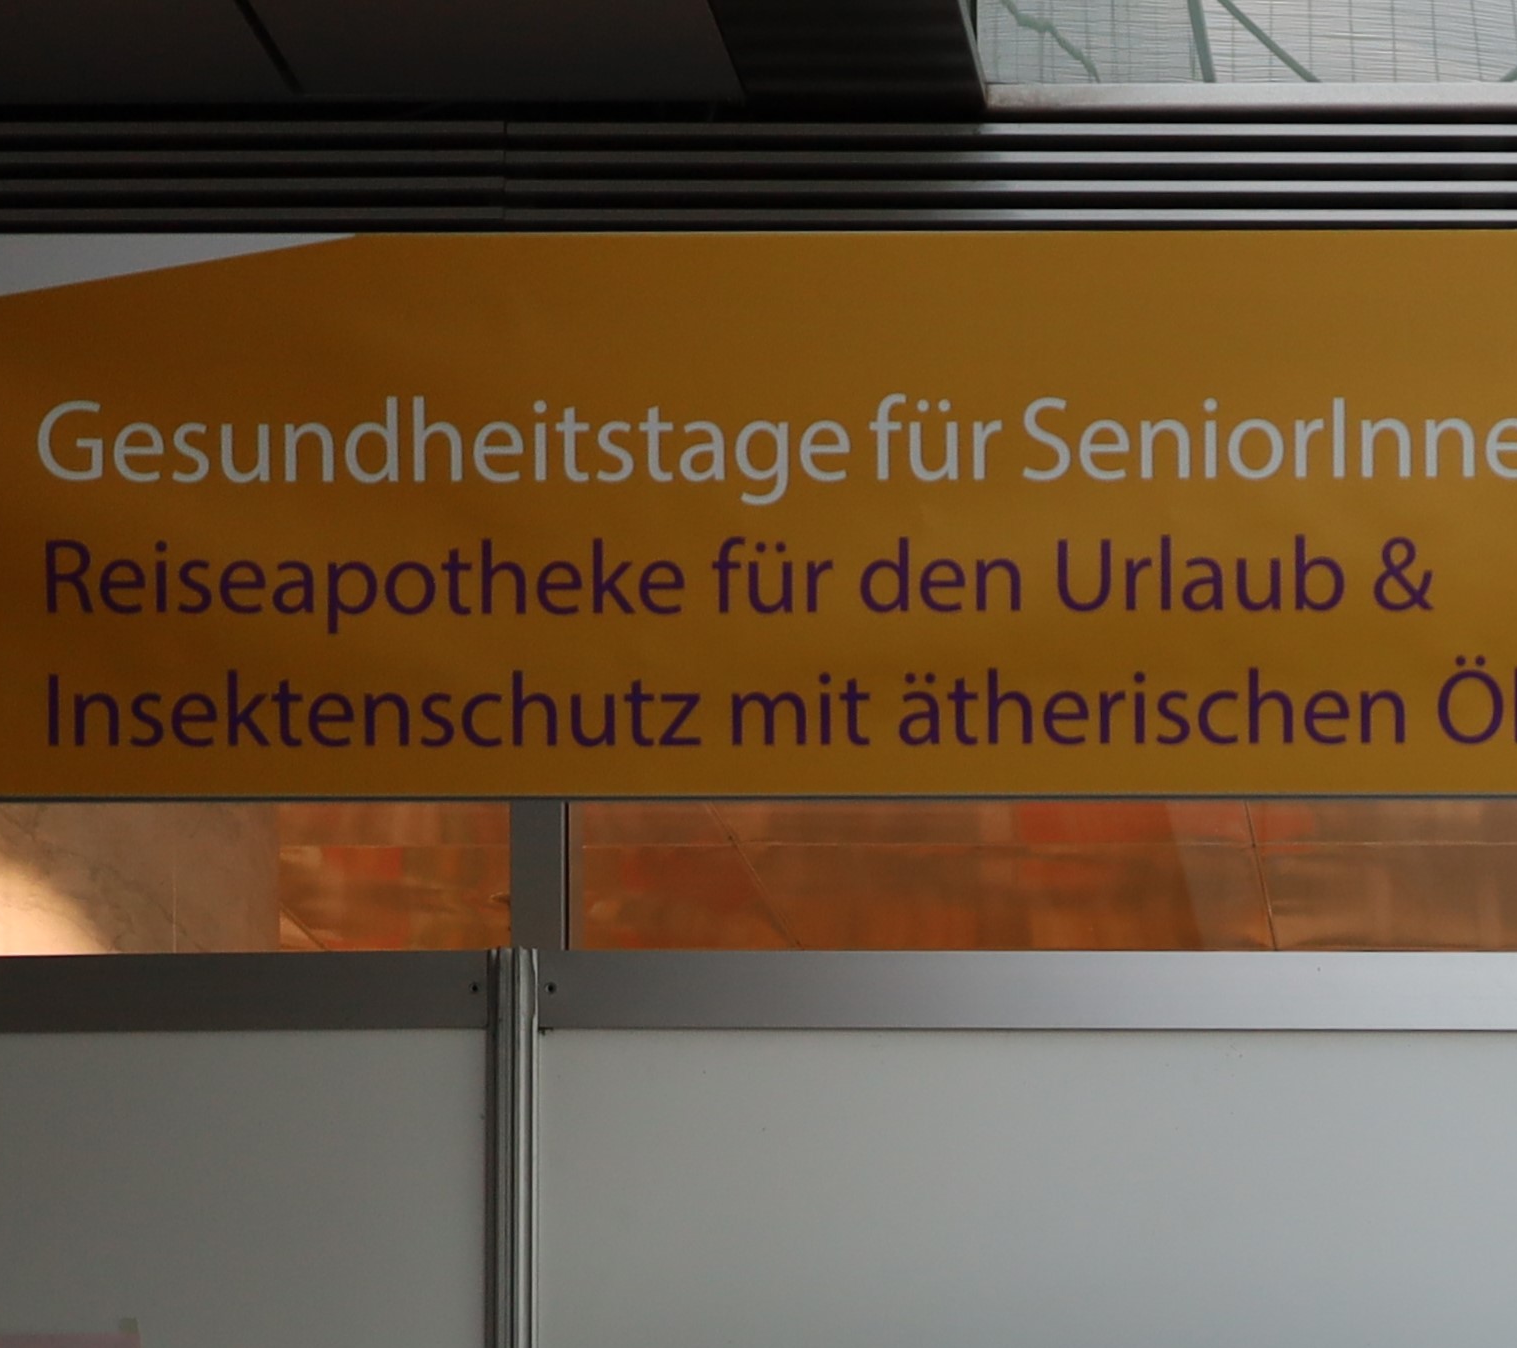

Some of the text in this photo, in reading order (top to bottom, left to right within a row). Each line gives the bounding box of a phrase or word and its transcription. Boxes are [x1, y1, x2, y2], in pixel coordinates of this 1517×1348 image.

[38, 396, 851, 506] Gesundheitstage
[869, 393, 1002, 482] für
[37, 534, 1433, 635] Reiseapotheke für den Urlaub &
[47, 668, 701, 748] Insektenschutz
[731, 672, 870, 746] mit
[898, 667, 1405, 747] ätherischen
